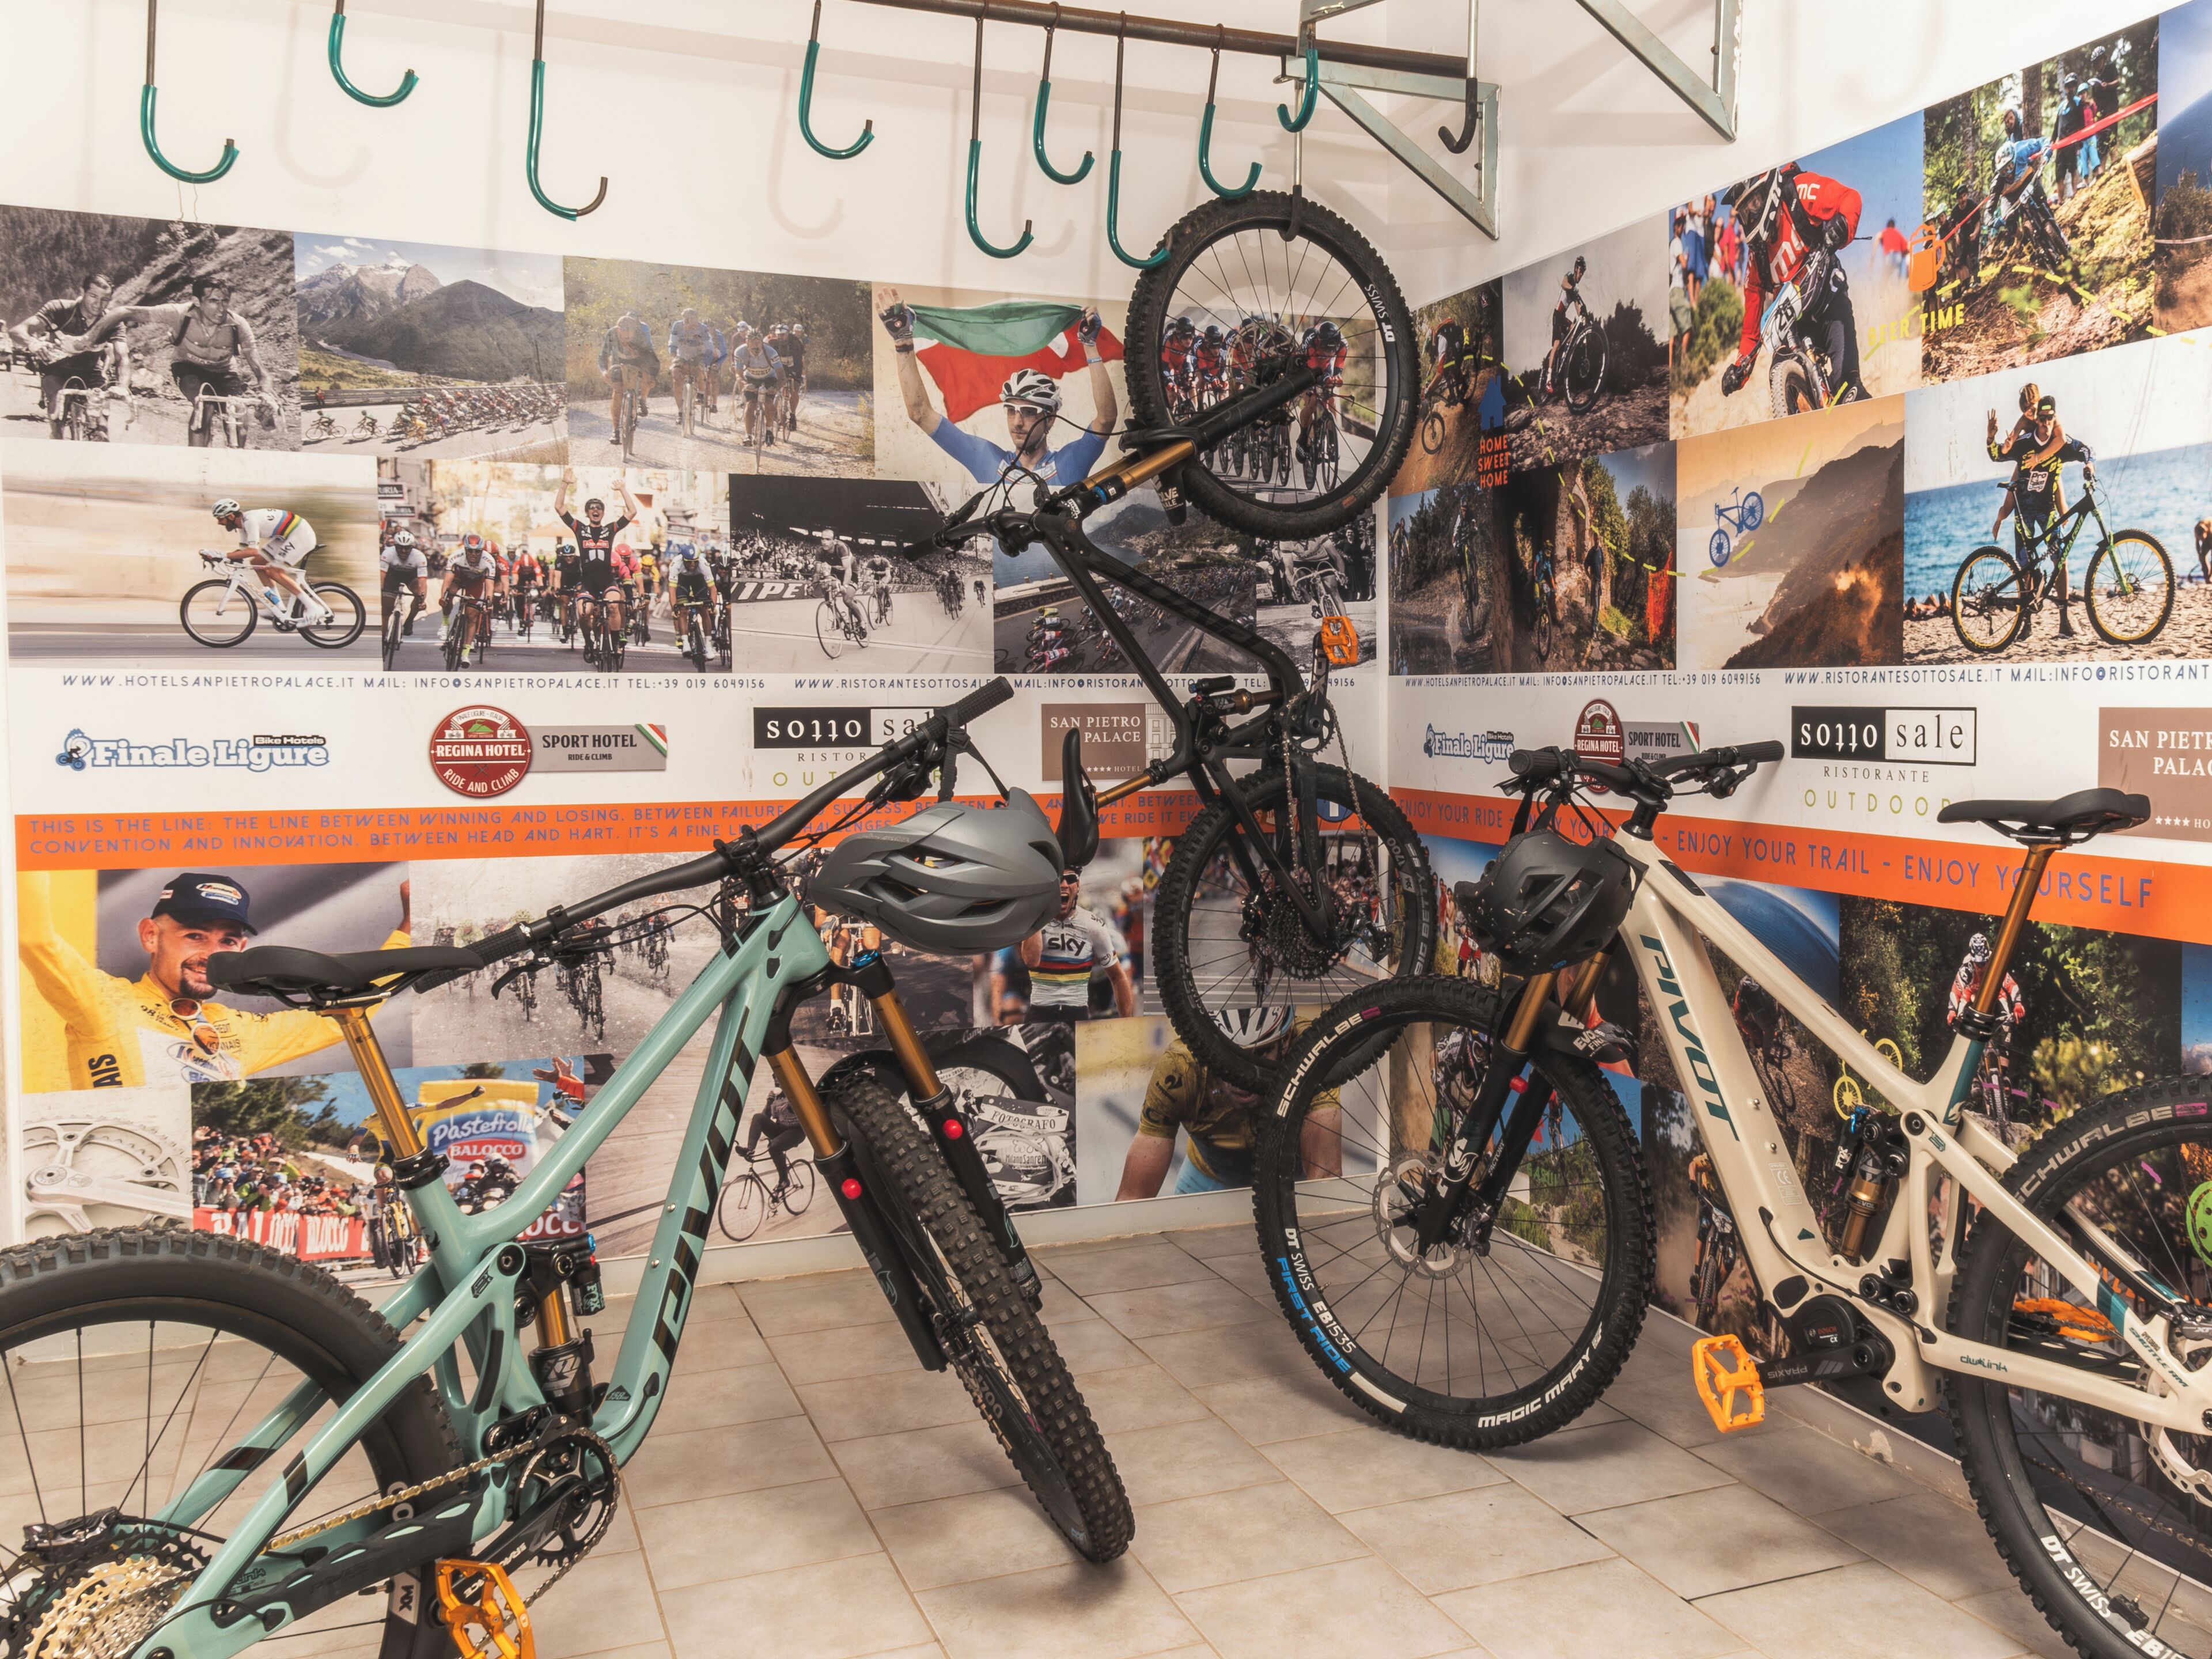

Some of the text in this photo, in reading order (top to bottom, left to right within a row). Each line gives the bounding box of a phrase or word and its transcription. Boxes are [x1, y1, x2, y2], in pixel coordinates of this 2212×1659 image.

[1365, 284, 1396, 343] DT SWISS
[1868, 303, 1965, 346] BEER TIME
[1479, 434, 1508, 453] HOME
[1478, 452, 1510, 472] SWEET
[1479, 473, 1509, 488] HOME
[1164, 498, 1177, 507] ALE
[730, 582, 803, 600] IPE
[62, 675, 355, 688] WWW.HOTELSANPIETROPALACE.IT
[363, 677, 406, 688] MAIL:
[414, 677, 619, 689] INFO@SANPIETROPALACE.IT
[686, 679, 709, 689] 019
[713, 679, 765, 689] 6049156
[794, 677, 991, 690] WWW.RISTORANTESOTTOSAL
[1327, 677, 1355, 687] 49156
[1404, 675, 1516, 688] WWW.HOTELSANPIETROPALACE.IT
[1519, 676, 1540, 687] MAIL:
[1543, 674, 1657, 687] INFO@SANPIETROPALACE.IT
[1701, 673, 1717, 685] 019
[1721, 672, 1761, 685] 6049156
[1785, 668, 2002, 685] WWW.RISTORANTESOTTOSALE.IT
[882, 711, 931, 737] sa
[1050, 715, 1141, 728] SAN PIETRO
[1084, 730, 1141, 743] PALACE
[1487, 731, 1513, 741] Bike Hotels
[1628, 731, 1681, 748] SPORT HOTEL
[1896, 713, 1964, 749] sale
[2109, 729, 2149, 749] SAN
[255, 736, 325, 745] Bike Hotels
[542, 734, 638, 749] SPORT HOTEL
[1434, 733, 1515, 765] Finale Ligure
[1577, 739, 1620, 753] REGINA HOTEL
[90, 738, 330, 772] Finale Ligure
[436, 744, 525, 757] REGINA HOTEL
[567, 753, 586, 761] RIDE
[593, 753, 612, 761] CLIMB
[797, 752, 866, 762] RISTOR
[1641, 752, 1650, 760] RIDE
[443, 768, 520, 793] RIDE AND CLIMB
[1824, 766, 1930, 783] RISTORANTE
[29, 819, 75, 835] THIS
[86, 819, 104, 834] IS
[115, 819, 152, 832] THE
[162, 818, 212, 832] LINE:
[224, 817, 259, 831] THE
[269, 816, 309, 830] LINE
[320, 814, 410, 828] BETWEEN
[419, 811, 502, 825] WINNING
[510, 810, 547, 824] AND
[556, 809, 624, 823] LOSING.
[634, 806, 713, 821] BETWEEN
[722, 805, 785, 819] FAILURE
[1399, 799, 1433, 819] ENJOY
[1436, 803, 1469, 824] YOUR
[1475, 807, 1503, 828] RIDE
[29, 837, 171, 854] CONVENTION
[182, 836, 224, 850] AND
[233, 834, 360, 849] INNOVATION.
[370, 831, 459, 846] BETWEEN
[467, 829, 514, 843] HEAD
[524, 828, 560, 842] AND
[569, 826, 620, 840] HART.
[628, 825, 658, 839] IT'S
[668, 825, 679, 837] A
[687, 824, 721, 836] FINE
[803, 819, 892, 834] HALENGES
[1124, 811, 1155, 824] RIDE
[1161, 810, 1172, 824] IT
[1677, 830, 1732, 858] ENJOY
[1743, 838, 1796, 865] YOUR
[1808, 844, 1869, 874] TRAIL
[1904, 854, 1980, 888] ENJOY
[1414, 871, 1431, 976] BIG BETTY
[1047, 933, 1086, 957] sky
[215, 1023, 232, 1033] REDIT
[1573, 1029, 1597, 1051] EVO
[1588, 1037, 1604, 1051] FINA
[1639, 934, 1741, 1142] PIVOT
[1276, 1013, 1363, 1119] SCHWALBE
[449, 1143, 523, 1157] BALOCCO
[1005, 1153, 1047, 1165] MilanoSanre
[1835, 1145, 1853, 1169] FOX
[1285, 1228, 1356, 1354] DT SWISS EB1535
[1276, 1257, 1351, 1373] FIRST RIDE
[1767, 1365, 1808, 1379] PRAXIS
[1477, 1347, 1592, 1428] MAGIC MARY
[2040, 1535, 2188, 1659] DT SWISS EB1
